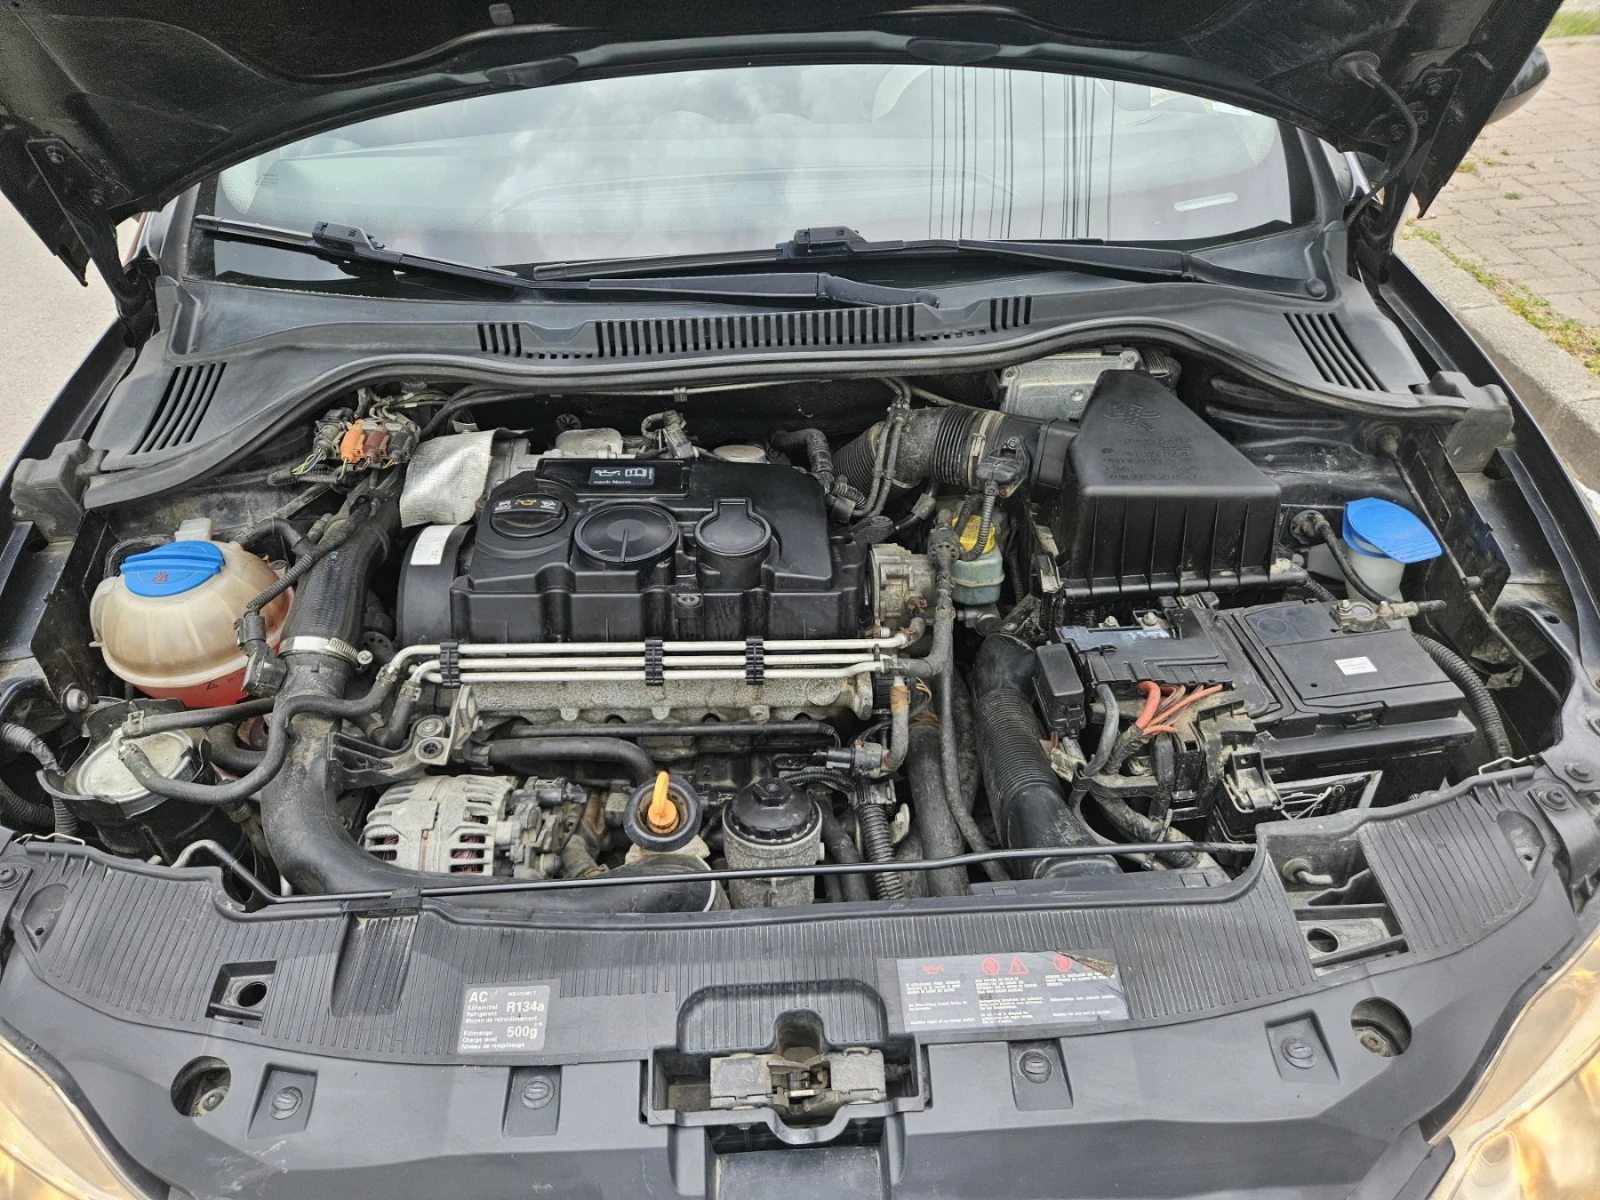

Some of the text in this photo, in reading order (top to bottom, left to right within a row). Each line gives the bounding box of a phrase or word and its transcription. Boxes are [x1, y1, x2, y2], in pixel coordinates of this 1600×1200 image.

[468, 991, 488, 1003] AC
[506, 1001, 545, 1013] R134a
[465, 1017, 485, 1025] Moyen
[506, 1025, 538, 1039] 500g
[462, 1036, 483, 1044] Charge
